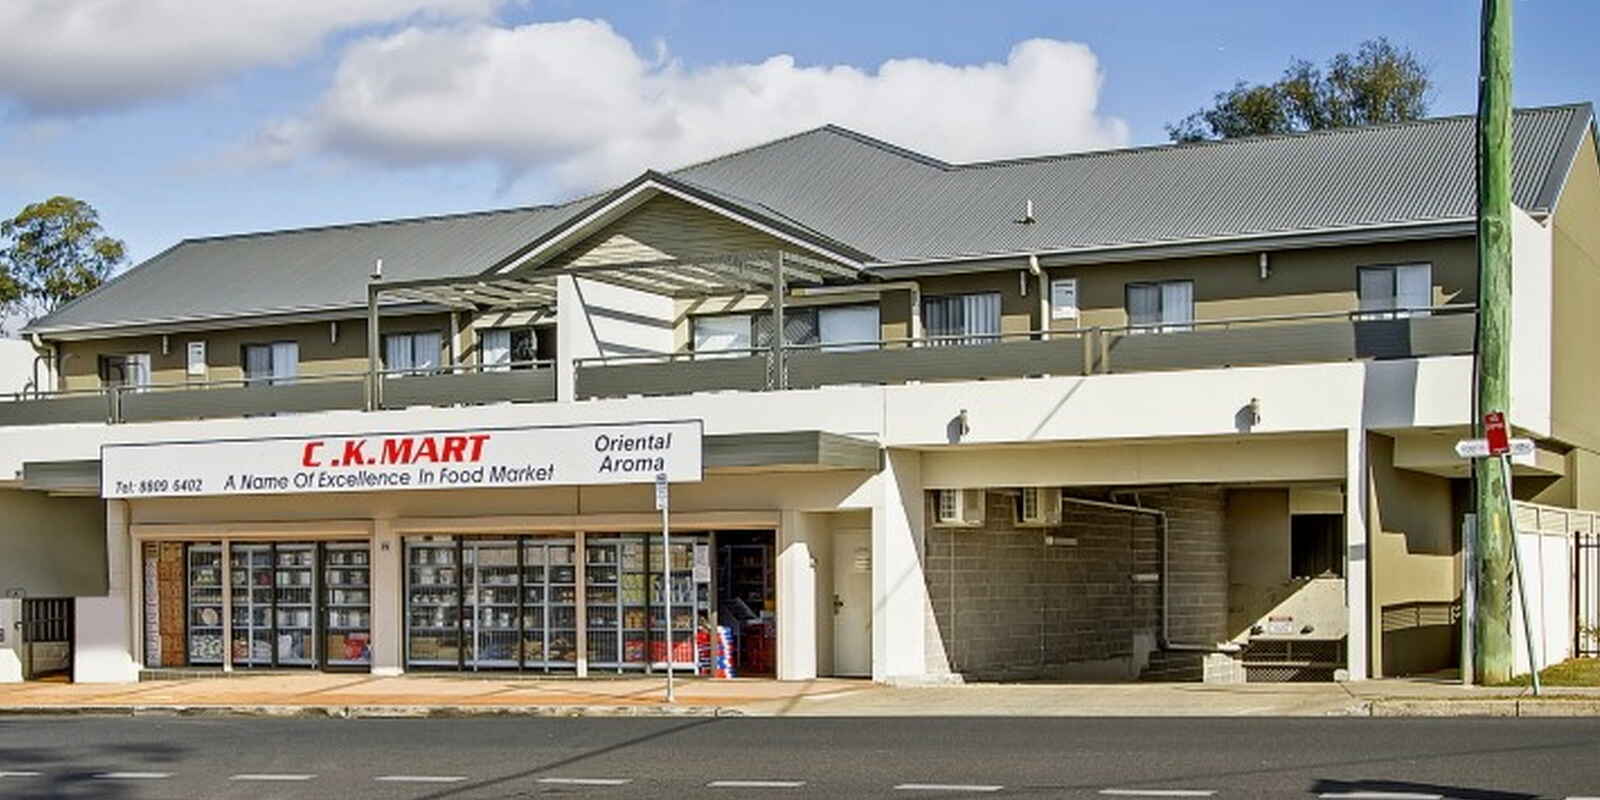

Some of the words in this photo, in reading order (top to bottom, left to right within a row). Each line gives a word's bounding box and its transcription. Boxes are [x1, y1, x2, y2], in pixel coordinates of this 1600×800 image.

[594, 432, 672, 453] Oriental
[598, 455, 664, 473] Aroma
[115, 480, 137, 494] Tel:
[223, 475, 237, 491] A
[239, 473, 288, 491] Name
[293, 471, 314, 489] Of
[318, 469, 411, 488] Excellence
[419, 468, 434, 484] In
[440, 466, 484, 484] Food
[489, 464, 554, 483] Market
